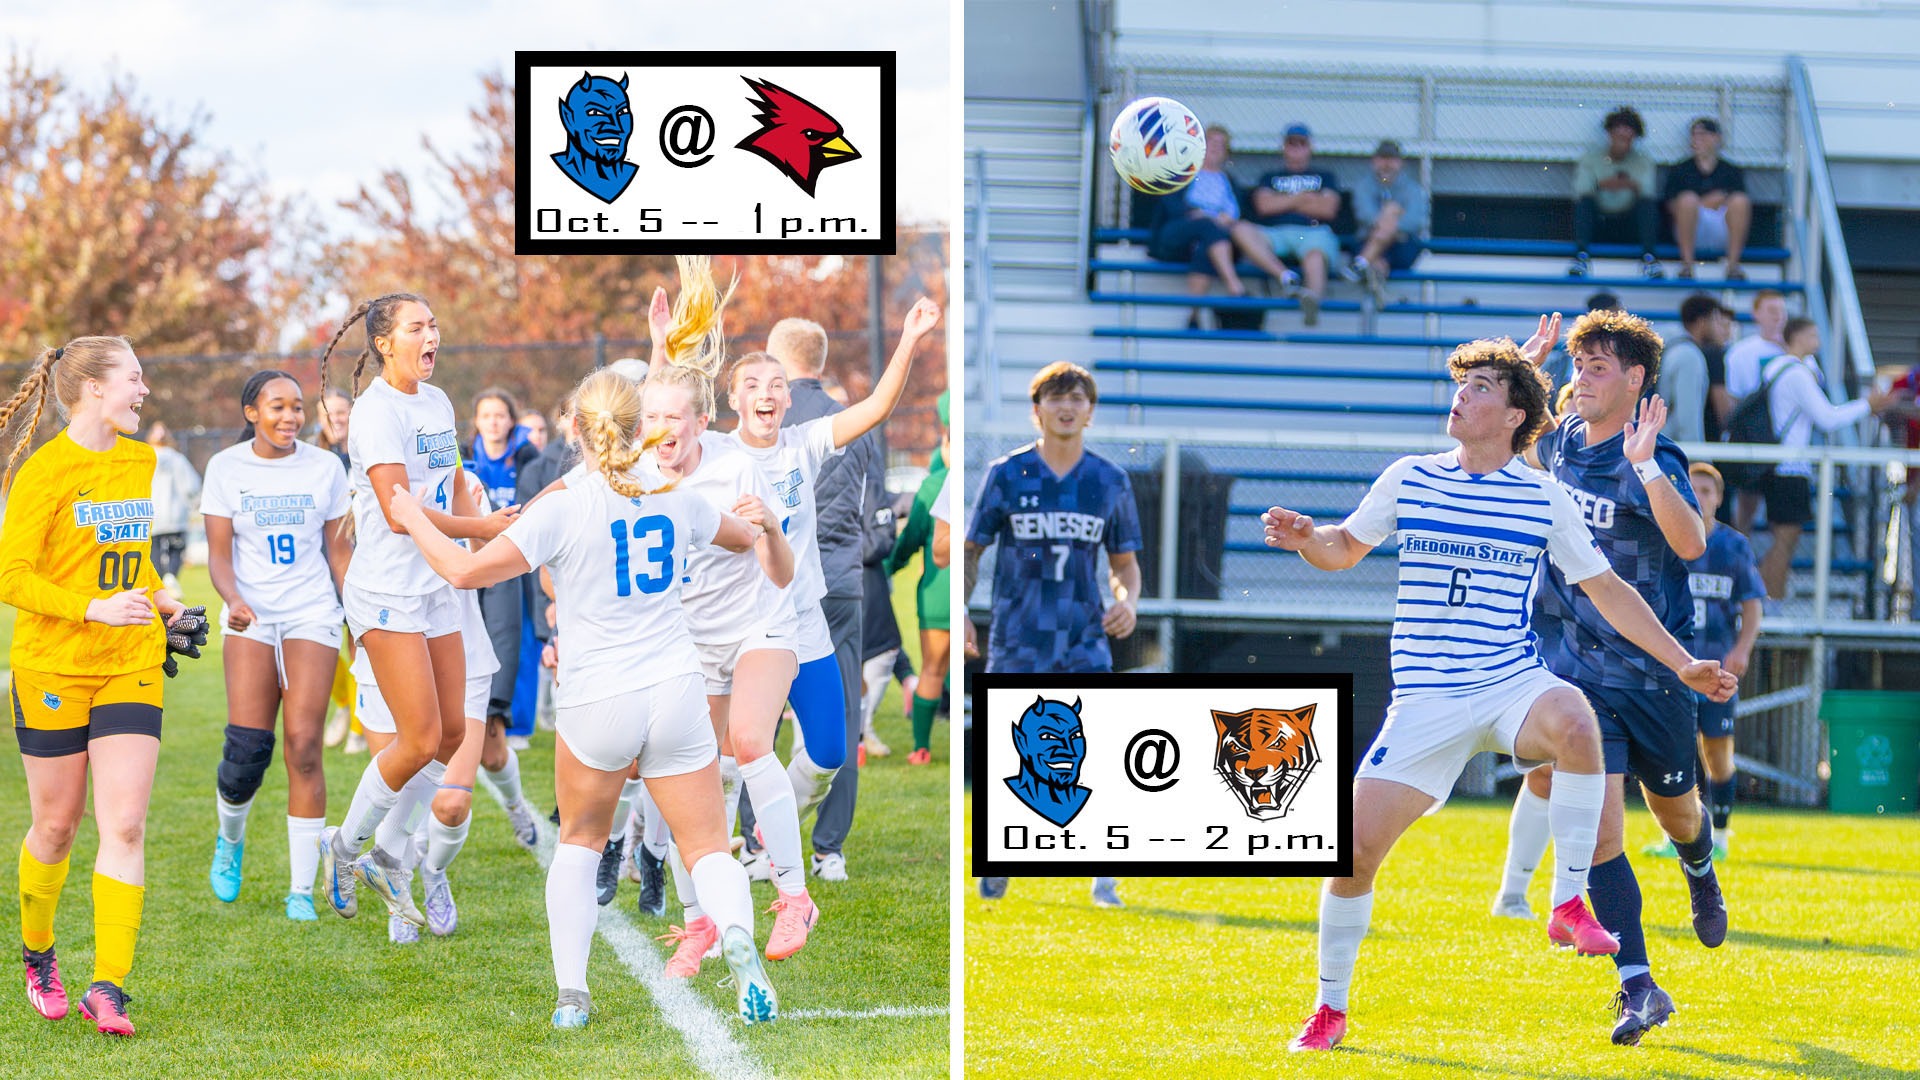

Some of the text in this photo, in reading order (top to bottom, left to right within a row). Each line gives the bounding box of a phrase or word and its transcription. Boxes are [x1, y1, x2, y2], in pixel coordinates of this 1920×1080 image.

[241, 494, 316, 512] FREDONIA
[435, 475, 448, 510] 4
[97, 521, 150, 543] STATE
[255, 510, 304, 526] STATE
[1009, 512, 1105, 543] GENESEO
[267, 534, 296, 565] 19
[610, 514, 675, 597] 13
[1050, 545, 1071, 582] 7
[1405, 535, 1525, 565] FREDONIA STATE
[98, 551, 142, 590] 00
[1447, 567, 1472, 608] 6
